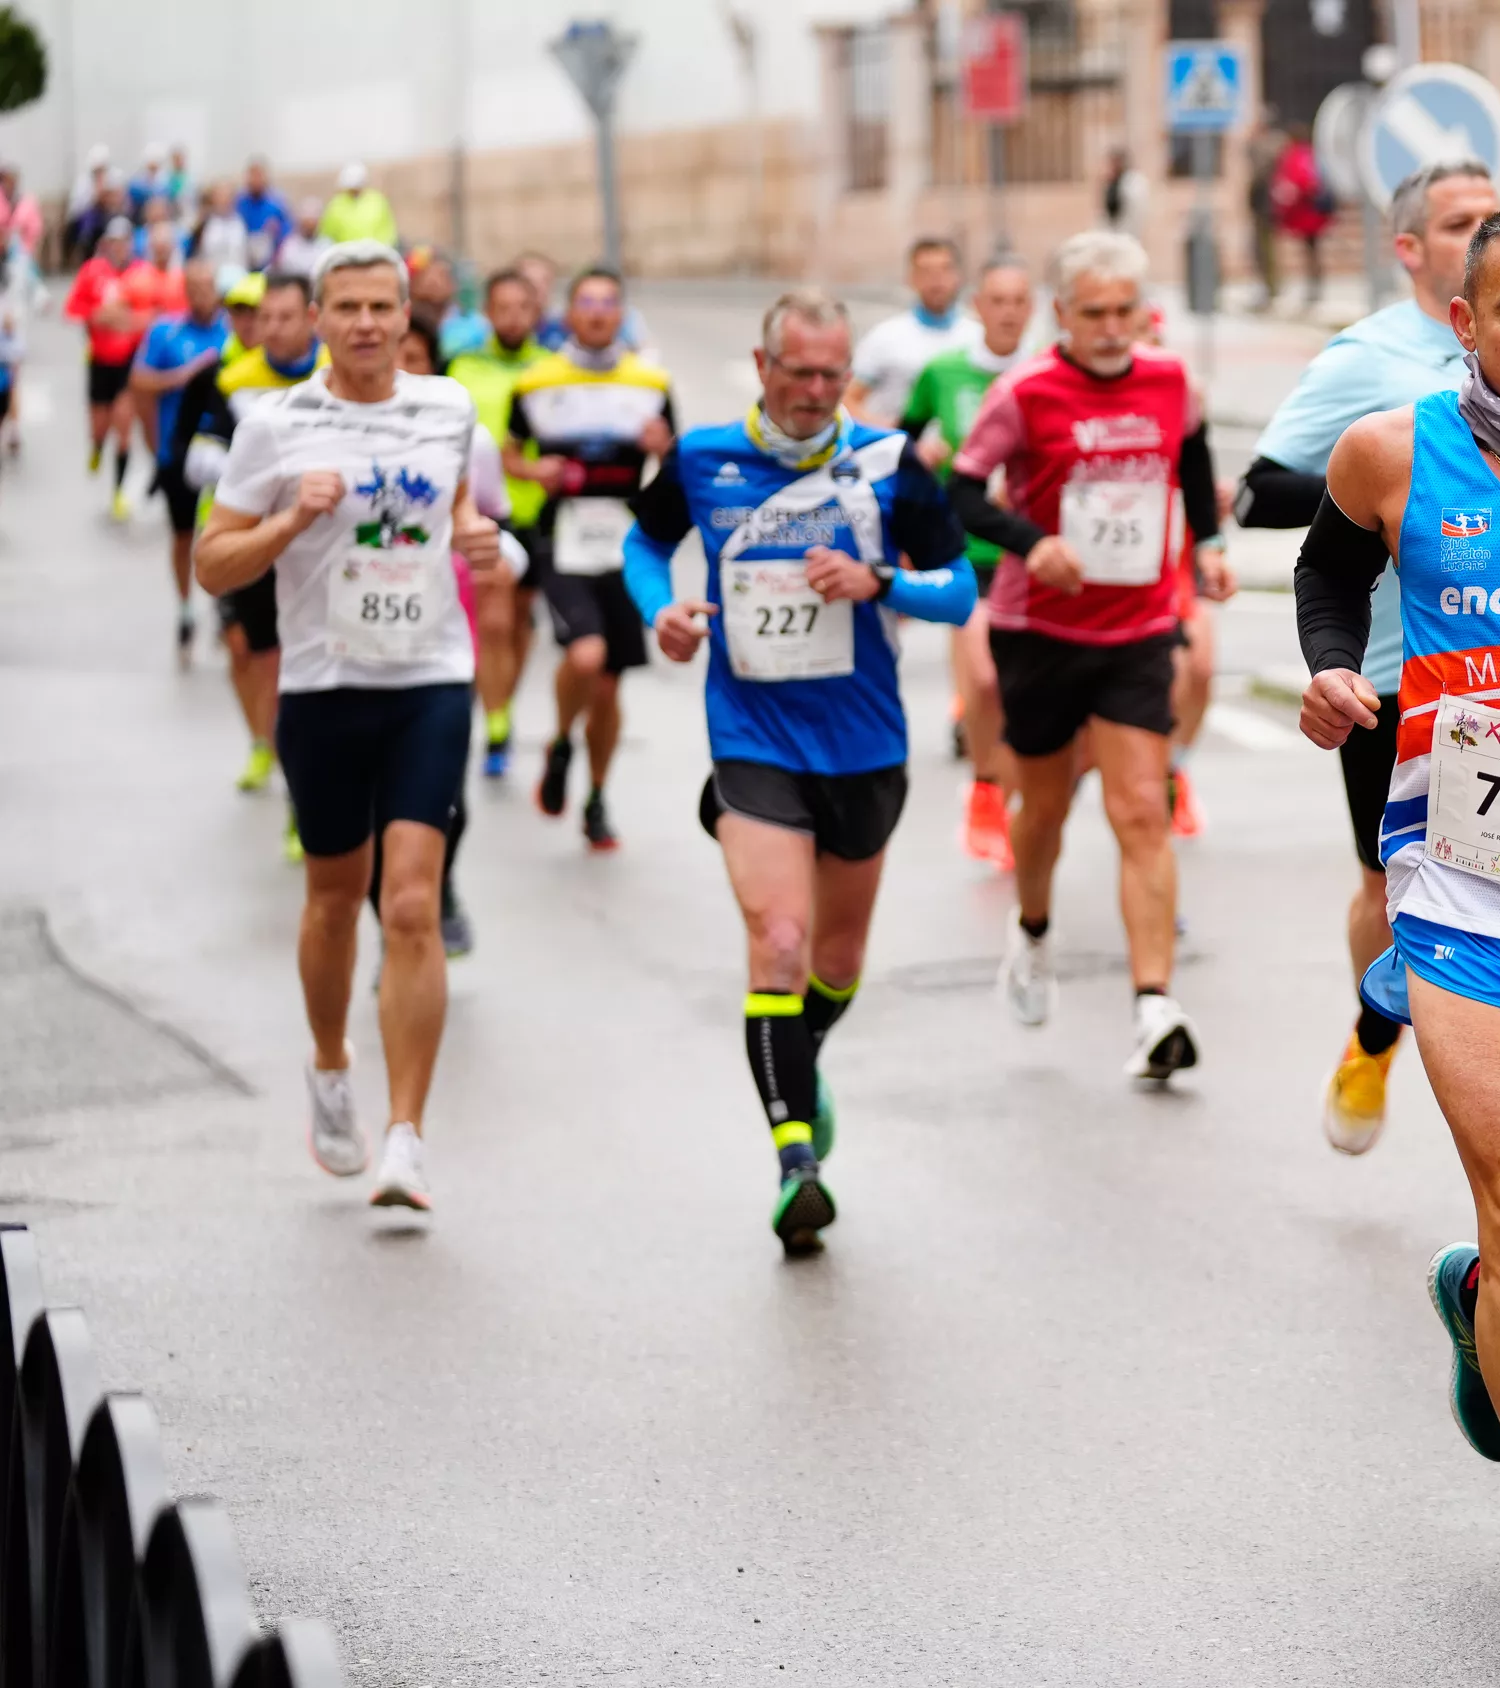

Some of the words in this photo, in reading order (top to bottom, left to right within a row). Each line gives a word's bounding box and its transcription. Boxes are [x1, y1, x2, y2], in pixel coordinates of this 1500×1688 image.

[1441, 537, 1470, 550] Club
[1441, 546, 1491, 562] Maratón
[1440, 560, 1487, 573] Lucena
[361, 592, 422, 622] 856
[756, 603, 821, 636] 227
[1480, 831, 1495, 840] JOSÉ
